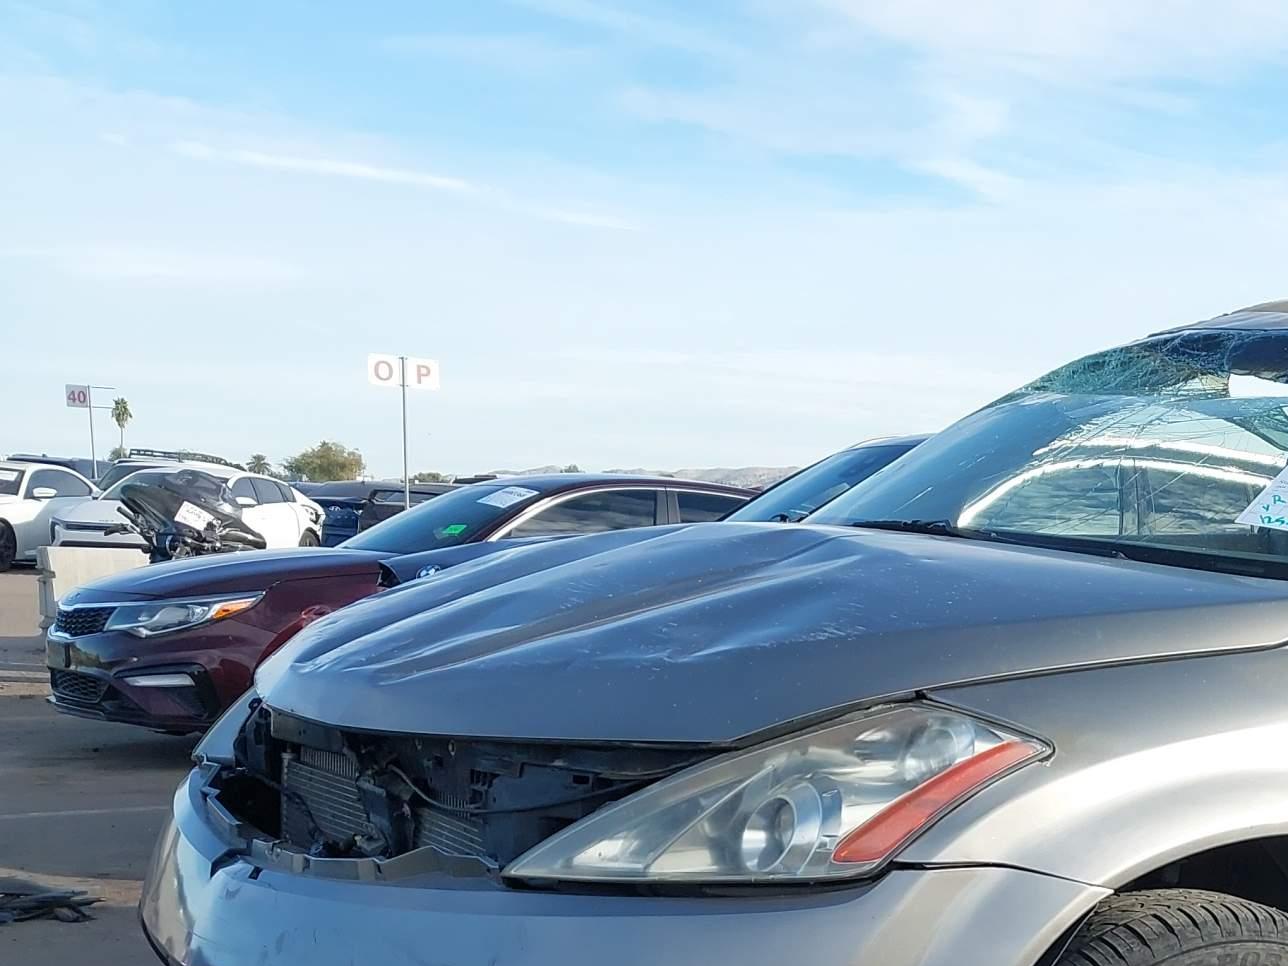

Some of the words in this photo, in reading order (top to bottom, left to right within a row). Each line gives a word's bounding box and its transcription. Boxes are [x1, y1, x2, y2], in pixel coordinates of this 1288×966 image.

[373, 360, 394, 382] O
[416, 364, 431, 385] P
[67, 389, 87, 404] 40
